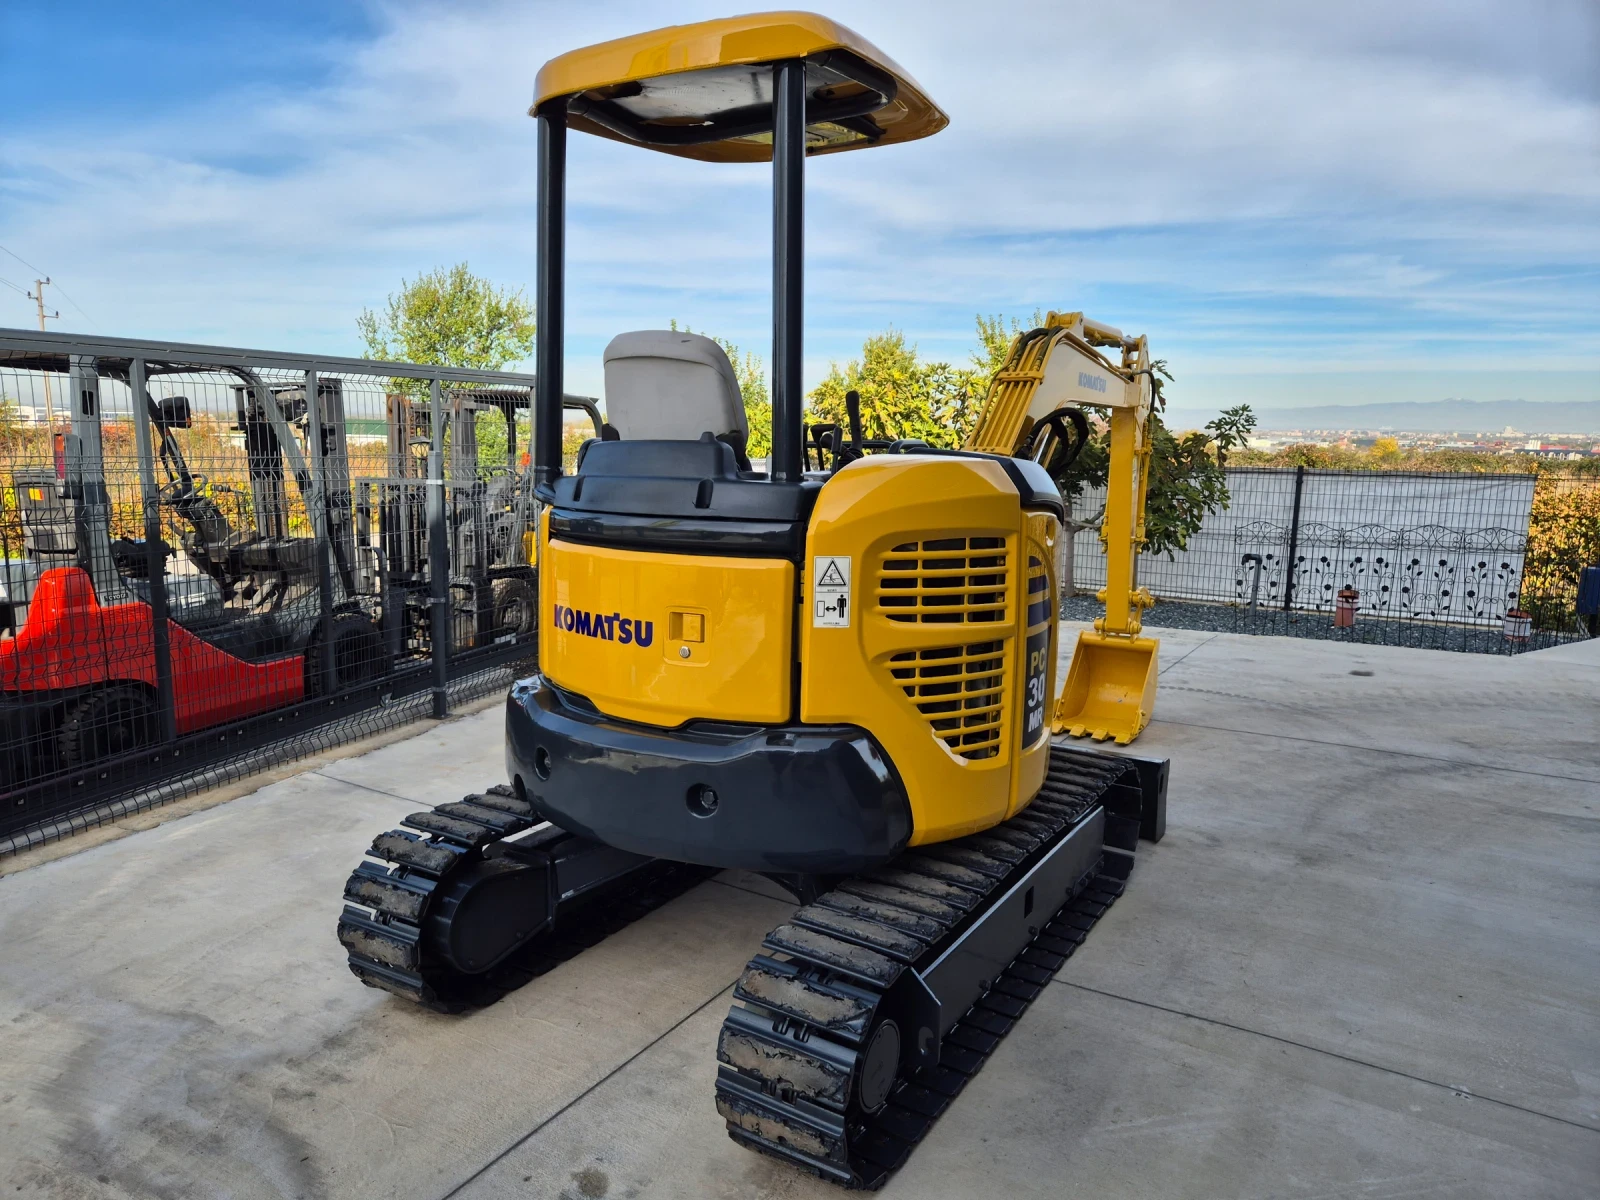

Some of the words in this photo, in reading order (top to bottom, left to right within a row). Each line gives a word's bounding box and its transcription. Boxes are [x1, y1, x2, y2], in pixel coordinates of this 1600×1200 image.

[1078, 371, 1107, 393] KOMATSU
[104, 593, 128, 601] OYOT
[554, 603, 653, 647] KOMATSU
[1030, 647, 1046, 676] PC
[1028, 672, 1045, 707] 30
[1028, 706, 1043, 733] MR
